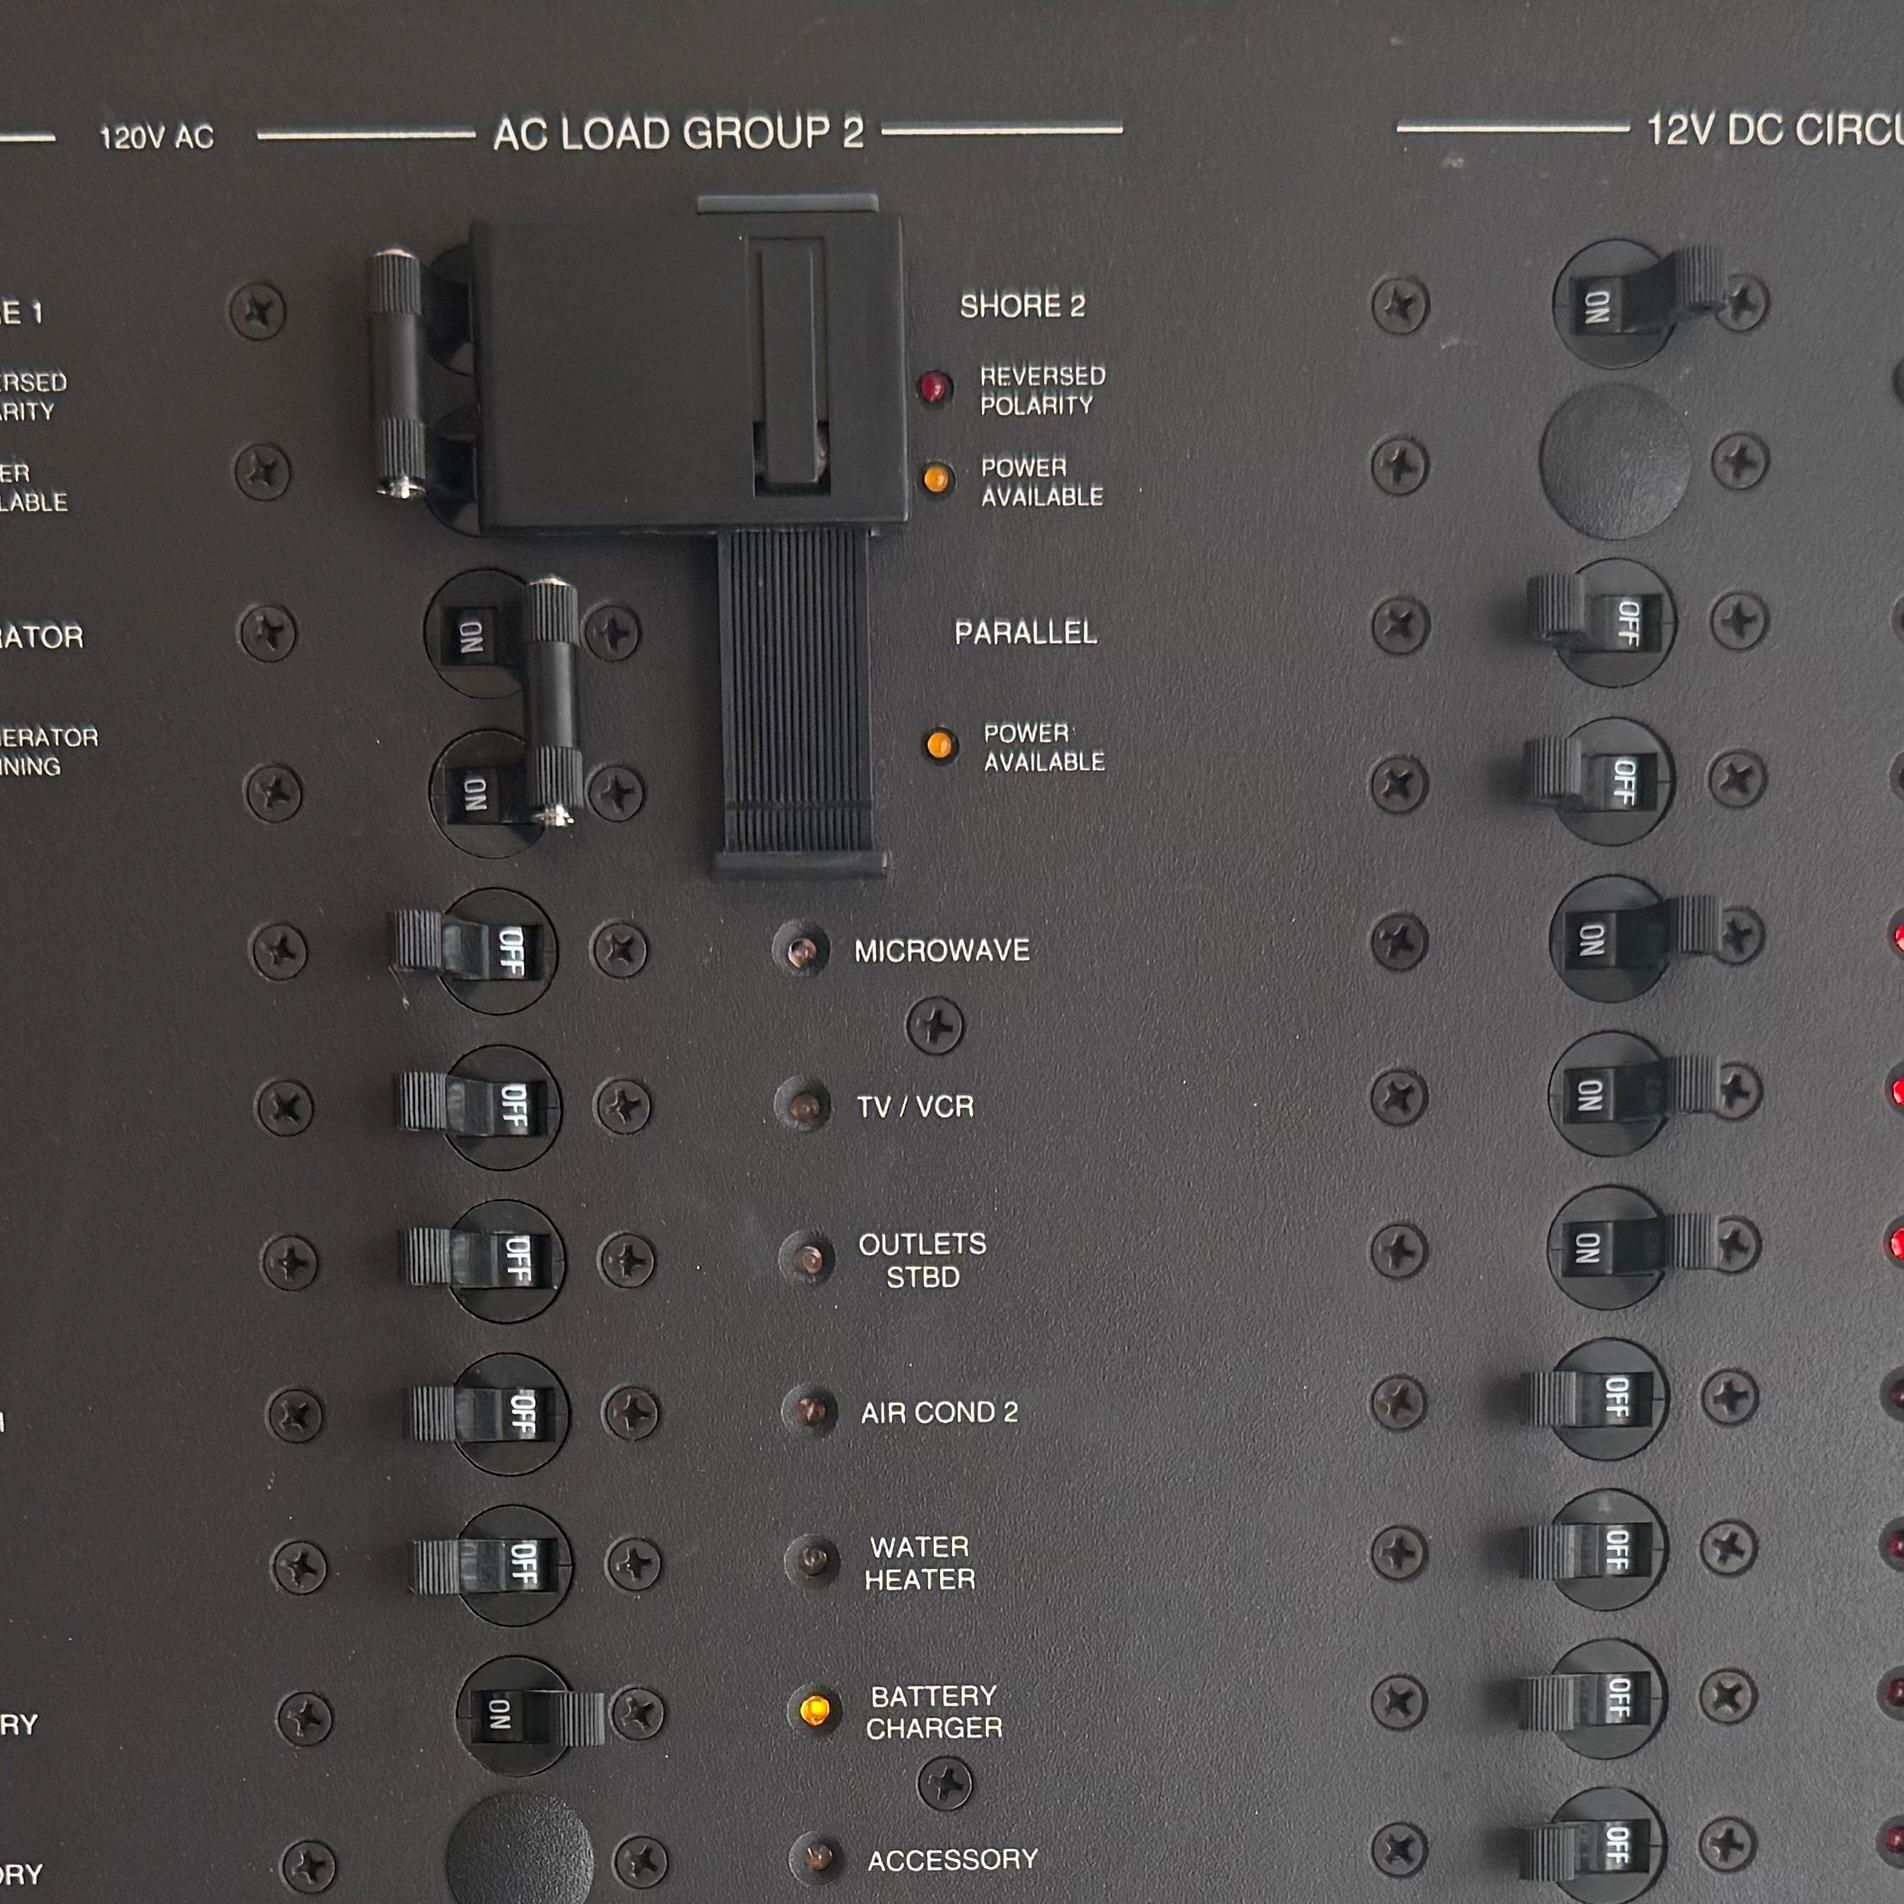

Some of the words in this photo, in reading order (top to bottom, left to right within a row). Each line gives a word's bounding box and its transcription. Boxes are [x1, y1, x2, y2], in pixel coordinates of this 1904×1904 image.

[100, 124, 166, 150] 120V
[174, 123, 214, 149] AC
[493, 116, 548, 151] AC
[562, 116, 670, 150] LOAD
[683, 114, 831, 150] GROUP
[843, 115, 864, 148] 2
[1648, 111, 1716, 145] 12V
[1729, 112, 1784, 146] DC
[33, 301, 42, 323] 1
[960, 292, 1061, 319] SHORE
[1070, 293, 1086, 317] 2
[1584, 289, 1611, 325] ON
[955, 619, 1098, 645] PARALLEL
[1616, 600, 1642, 648] OFF
[497, 928, 526, 977] OFF
[855, 937, 1030, 963] MICROWAVE
[1579, 923, 1607, 957] ON
[857, 1095, 892, 1118] TV
[915, 1094, 974, 1119] VCR
[859, 1231, 987, 1256] OUTLETS
[887, 1265, 961, 1289] STBD
[872, 1684, 998, 1708] BATTERY
[1607, 1676, 1632, 1720] OFF
[489, 1698, 512, 1731] ON
[866, 1716, 1003, 1741] CHARGER
[867, 1848, 1039, 1872] ACCESSORY
